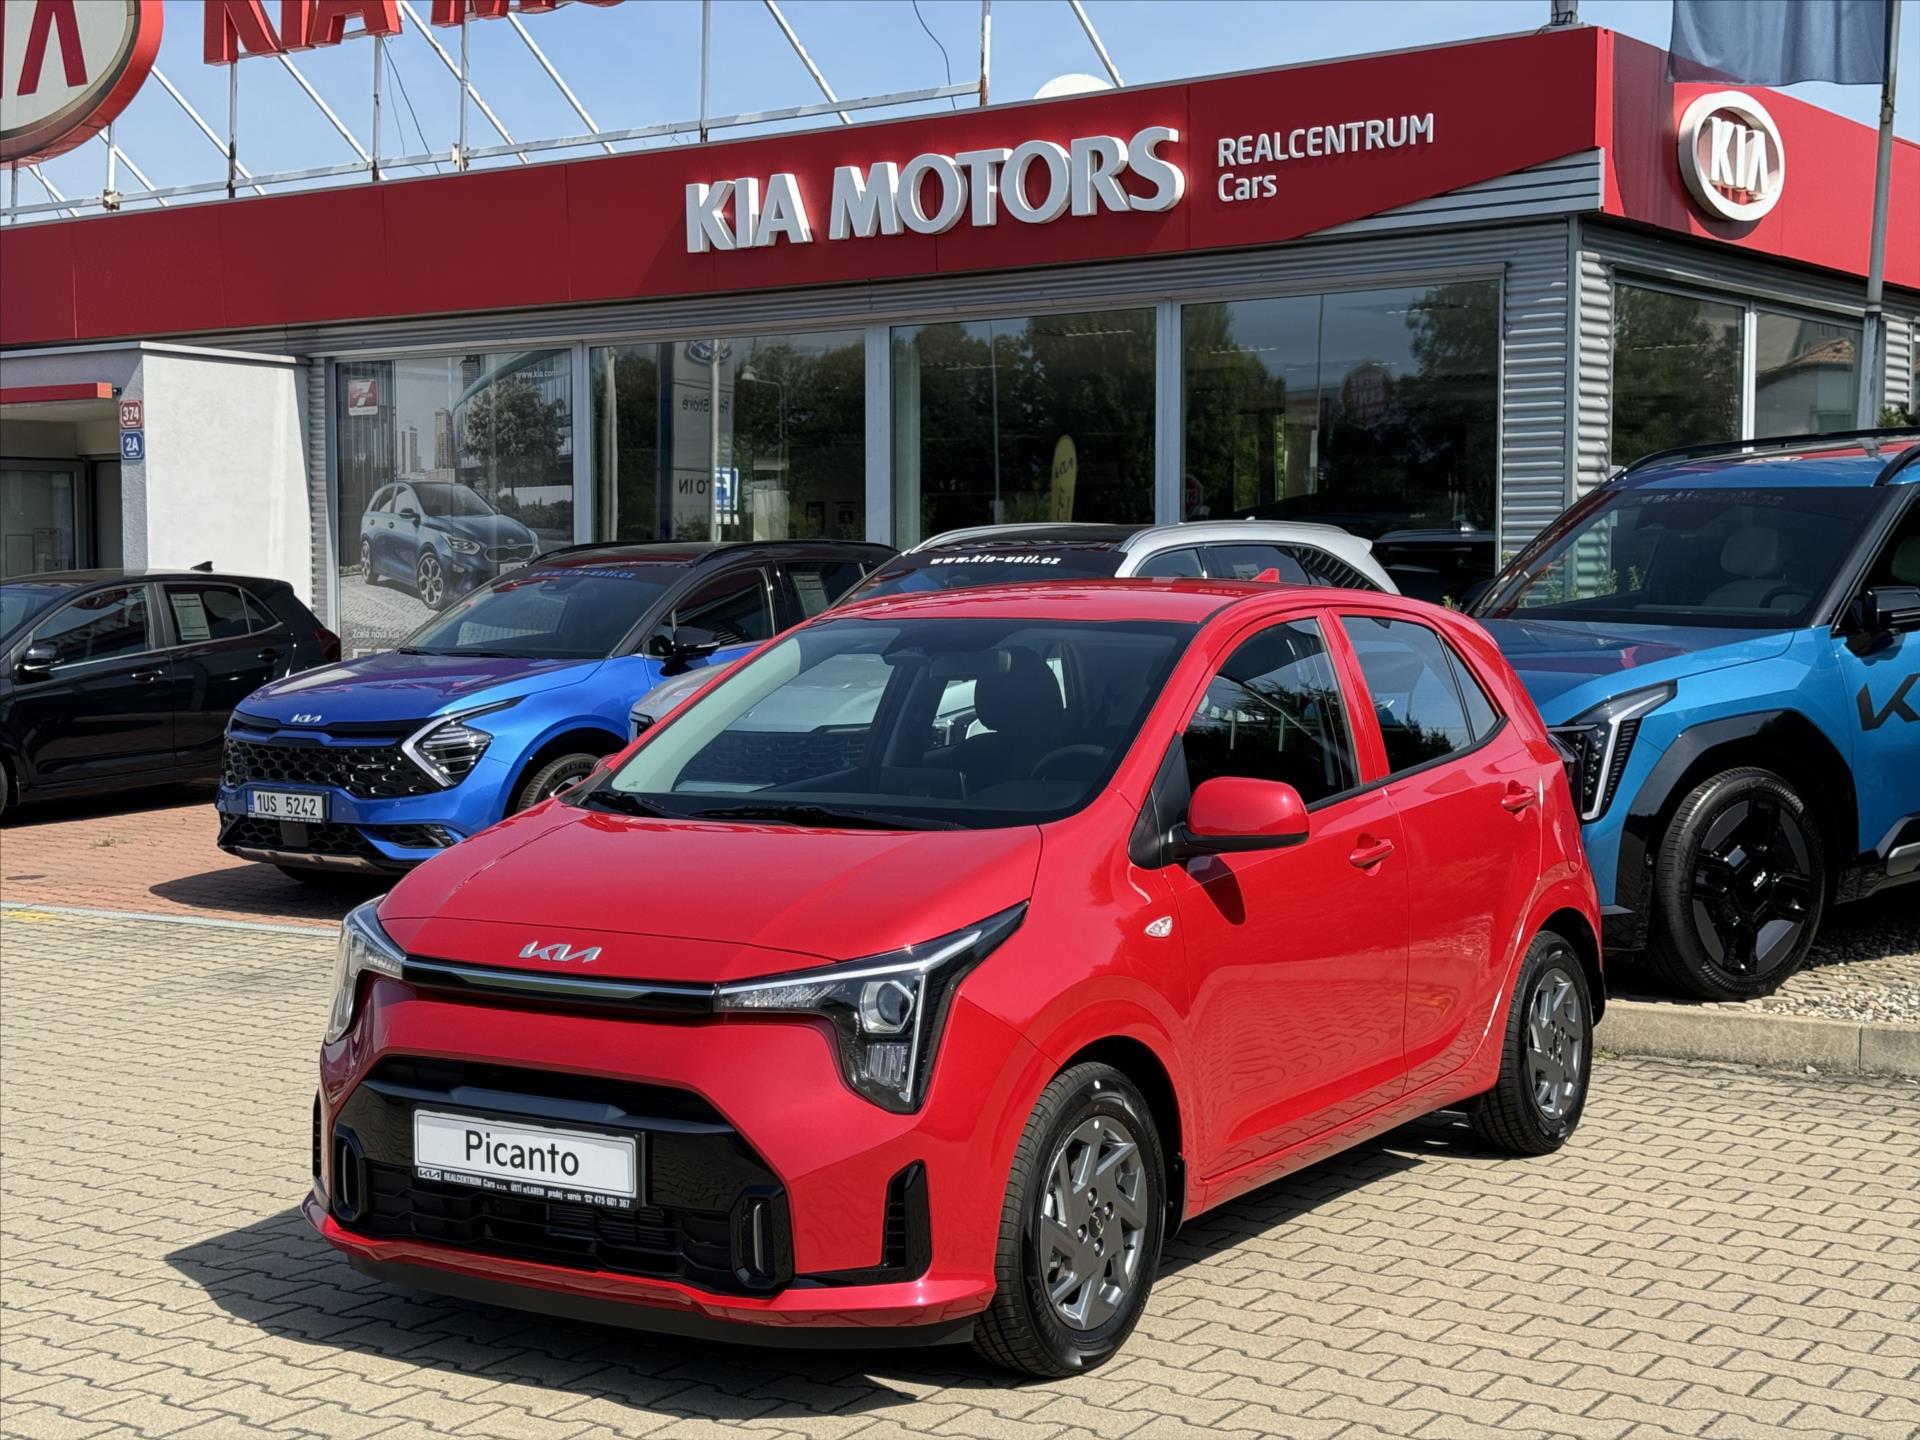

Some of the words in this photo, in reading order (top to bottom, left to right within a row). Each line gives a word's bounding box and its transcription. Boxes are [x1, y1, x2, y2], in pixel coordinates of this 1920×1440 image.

[1217, 113, 1434, 168] REALCENTRUM
[1710, 116, 1769, 195] KIA
[686, 173, 814, 253] KIA
[829, 126, 1186, 240] MOTORS
[1217, 173, 1277, 202] Cars
[122, 406, 139, 421] 374
[126, 437, 139, 451] 2A
[930, 555, 1061, 565] www.kia-usti.cz
[257, 794, 277, 813] 1US
[286, 796, 317, 816] 5242
[518, 940, 602, 964] KIA
[465, 1129, 579, 1176] Picanto
[483, 1178, 496, 1190] Cars
